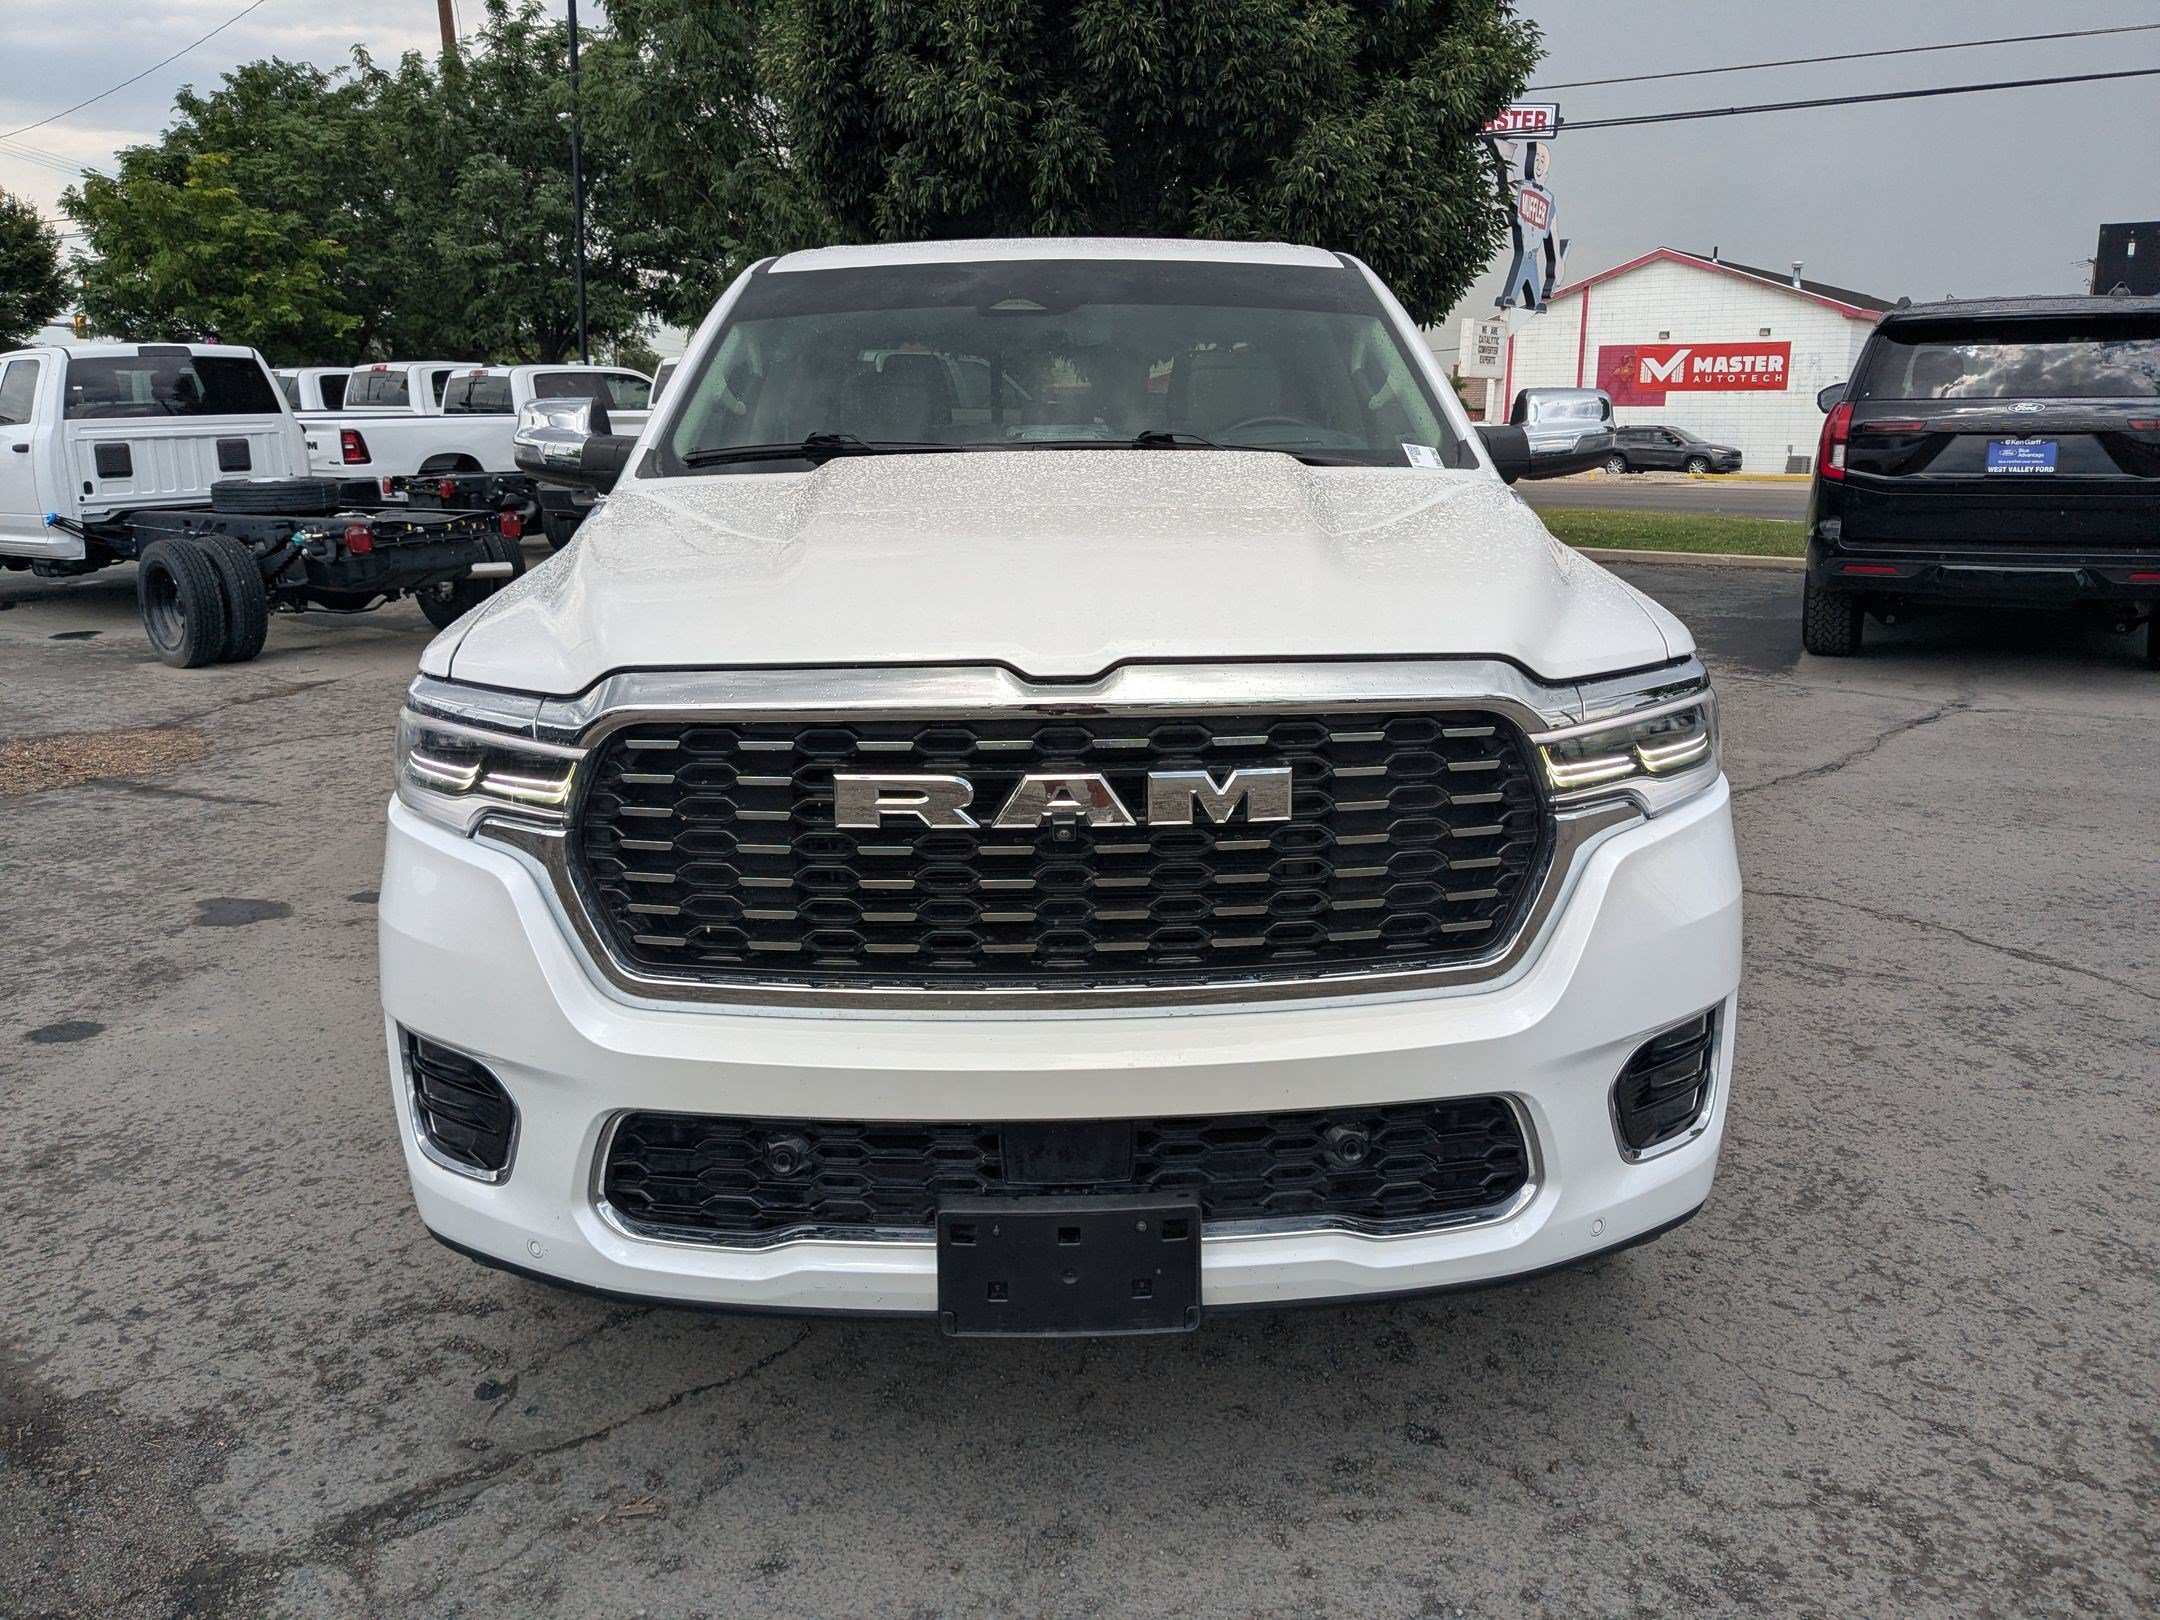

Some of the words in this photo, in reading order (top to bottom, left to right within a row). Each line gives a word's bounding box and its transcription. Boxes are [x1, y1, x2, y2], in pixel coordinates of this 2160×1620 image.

[1522, 192, 1547, 226] MUFFLER
[1482, 325, 1487, 334] WE
[1490, 326, 1498, 335] ARE
[1478, 335, 1500, 345] CATALYTIC
[1693, 355, 1784, 373] MASTER
[1693, 373, 1783, 383] AUTOTECH
[833, 766, 1293, 829] RAM
